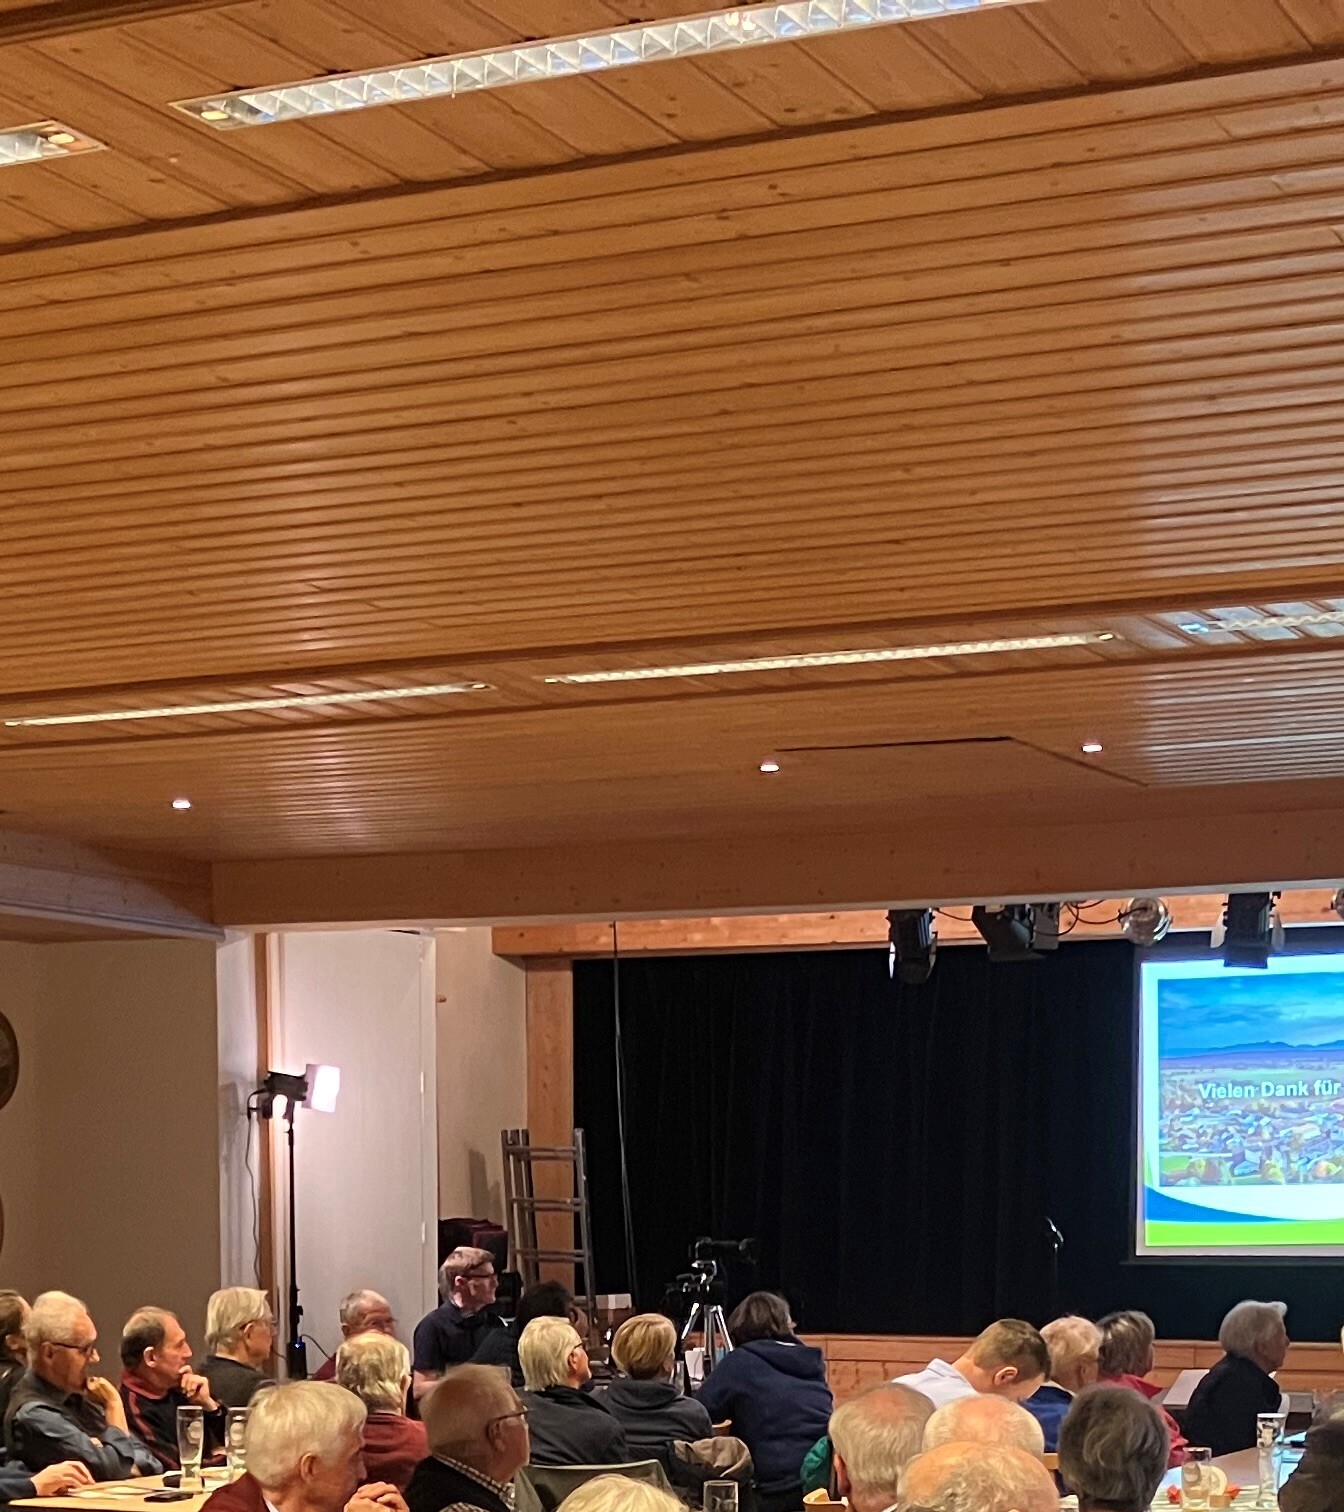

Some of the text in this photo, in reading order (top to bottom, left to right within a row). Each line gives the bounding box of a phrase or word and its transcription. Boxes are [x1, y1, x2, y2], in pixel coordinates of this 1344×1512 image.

[1198, 1083, 1255, 1100] Vielen
[1261, 1081, 1308, 1098] Dank
[1313, 1079, 1341, 1096] für
